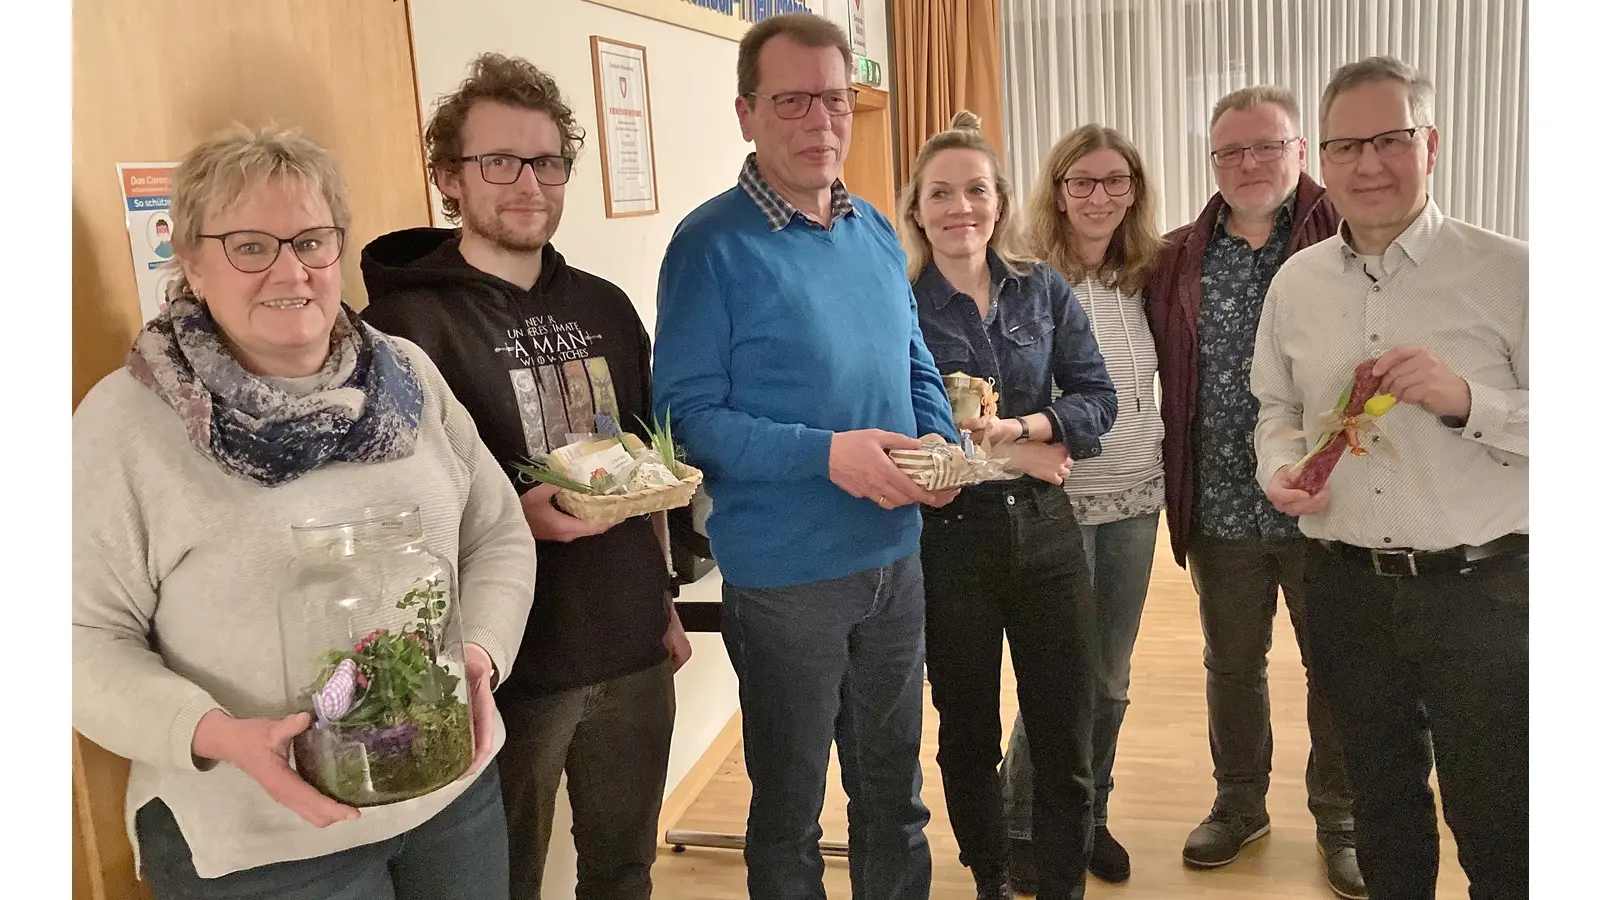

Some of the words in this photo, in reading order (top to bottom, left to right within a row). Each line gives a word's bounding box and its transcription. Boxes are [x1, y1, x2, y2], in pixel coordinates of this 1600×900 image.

[131, 176, 145, 185] Das
[134, 199, 144, 208] So
[525, 315, 556, 328] NEVR
[507, 321, 581, 339] UNERESIMATE
[515, 339, 530, 358] A
[532, 330, 588, 354] MAN
